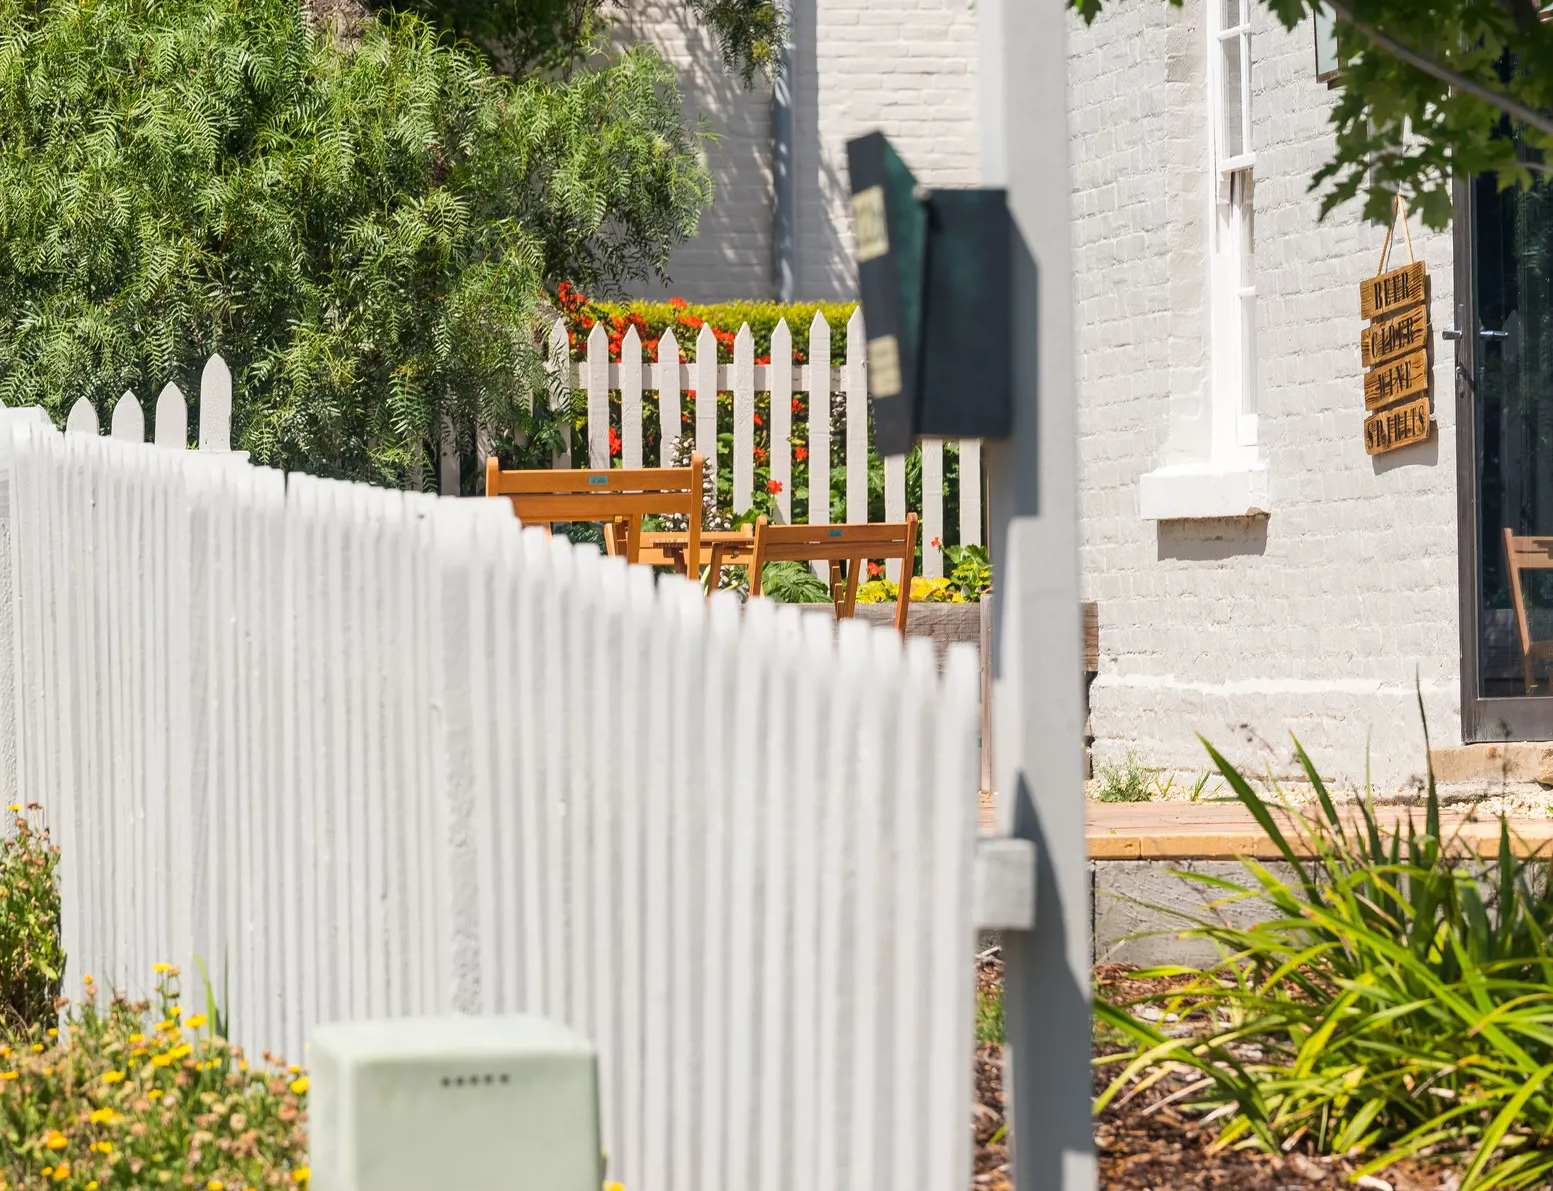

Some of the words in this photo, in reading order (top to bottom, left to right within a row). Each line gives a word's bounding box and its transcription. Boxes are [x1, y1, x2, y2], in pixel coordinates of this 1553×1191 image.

[1373, 271, 1409, 310] BEER
[1371, 317, 1415, 359] CIDER
[1377, 360, 1412, 399] WINE
[1367, 405, 1424, 449] SPIRITS
